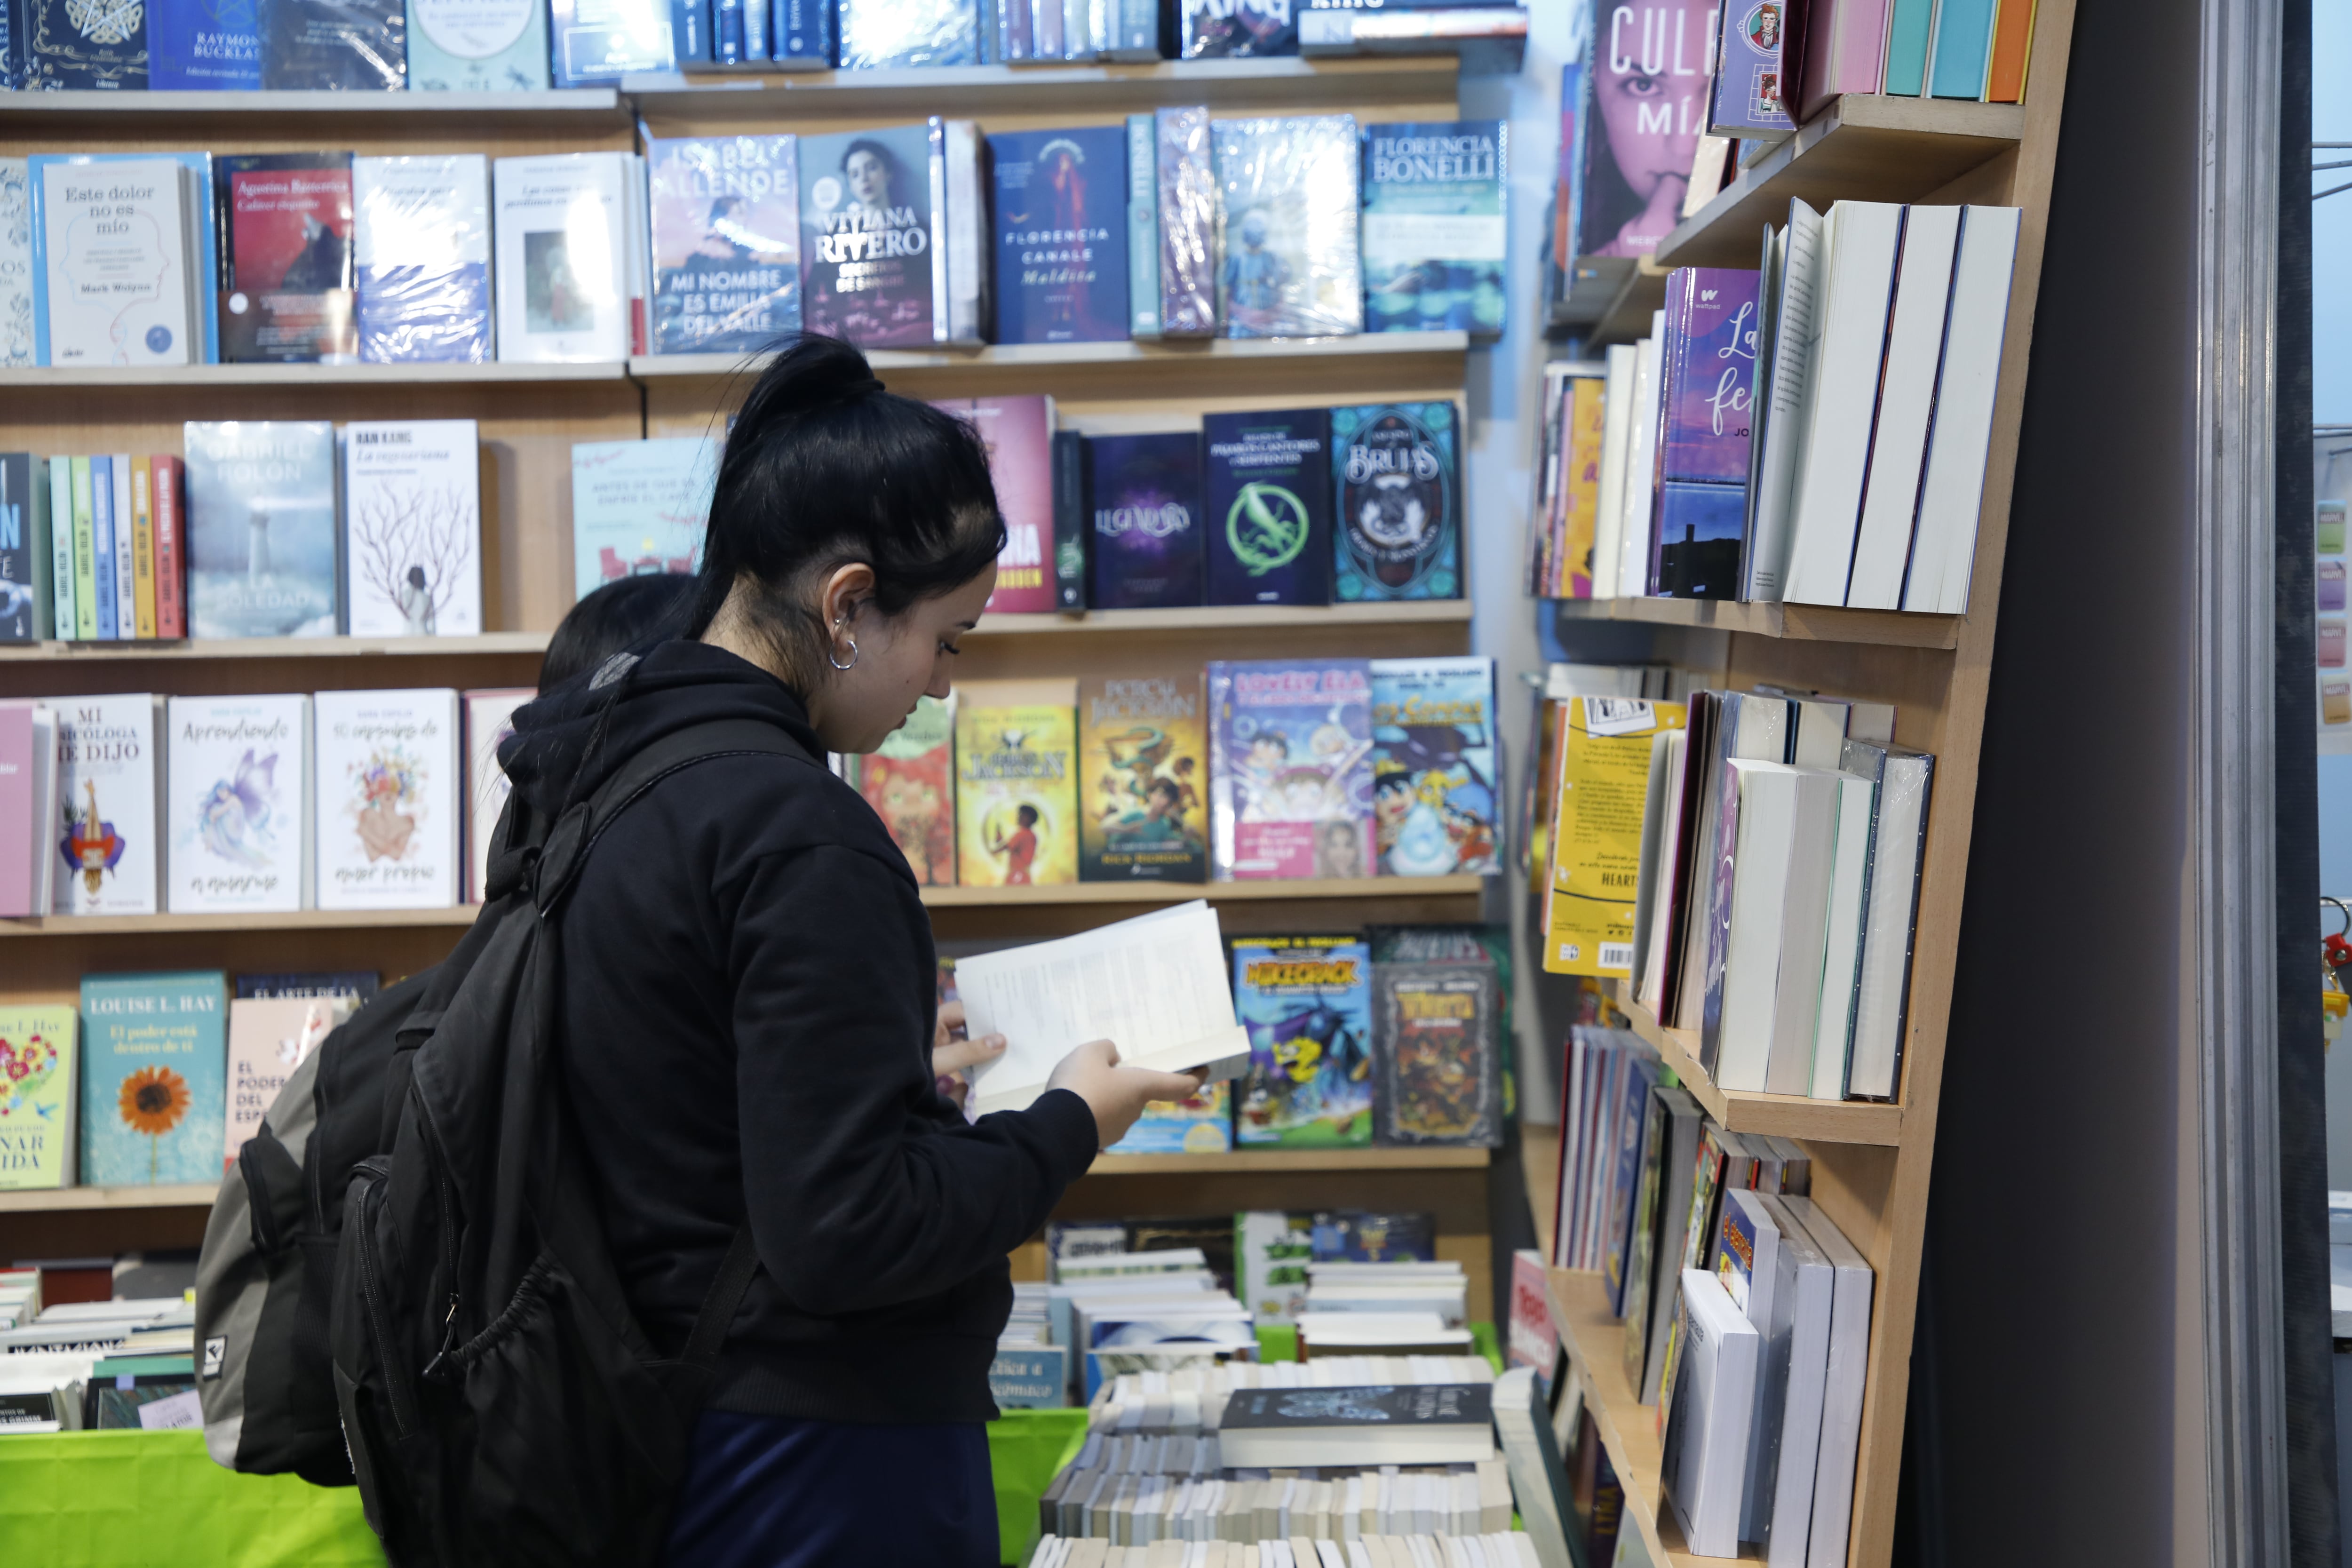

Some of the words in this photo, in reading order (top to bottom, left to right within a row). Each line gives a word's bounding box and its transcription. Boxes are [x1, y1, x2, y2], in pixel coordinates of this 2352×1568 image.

[197, 32, 259, 46] RAYMON
[194, 44, 260, 60] BUCKLA
[1374, 135, 1494, 158] FLORENCIA
[1374, 154, 1494, 183] BONELLI
[66, 187, 103, 203] Este
[108, 185, 154, 200] dolor
[90, 205, 111, 218] no
[116, 204, 135, 215] es
[96, 218, 129, 234] mío
[823, 206, 917, 235] VIVIANA
[815, 227, 927, 263] RIVERO
[1006, 228, 1109, 245] FLORENCIA
[1021, 248, 1093, 264] CANALE
[671, 273, 696, 291] MI
[699, 270, 782, 290] NOMBRE
[60, 724, 137, 741] SICÓLOGA
[87, 742, 139, 762] DIJO
[90, 996, 155, 1016] LOUISE
[160, 996, 176, 1013] L.
[180, 995, 217, 1013] HAY
[110, 1025, 124, 1039] El
[127, 1024, 166, 1042] poder
[169, 1023, 199, 1038] está
[114, 1039, 160, 1054] dentro
[163, 1039, 179, 1053] de
[182, 1038, 193, 1053] ti
[238, 1060, 253, 1075] EL
[237, 1094, 262, 1107] DEL
[236, 1110, 268, 1123] ESP
[0, 1135, 43, 1151] NAR
[2, 1153, 40, 1170] IDA
